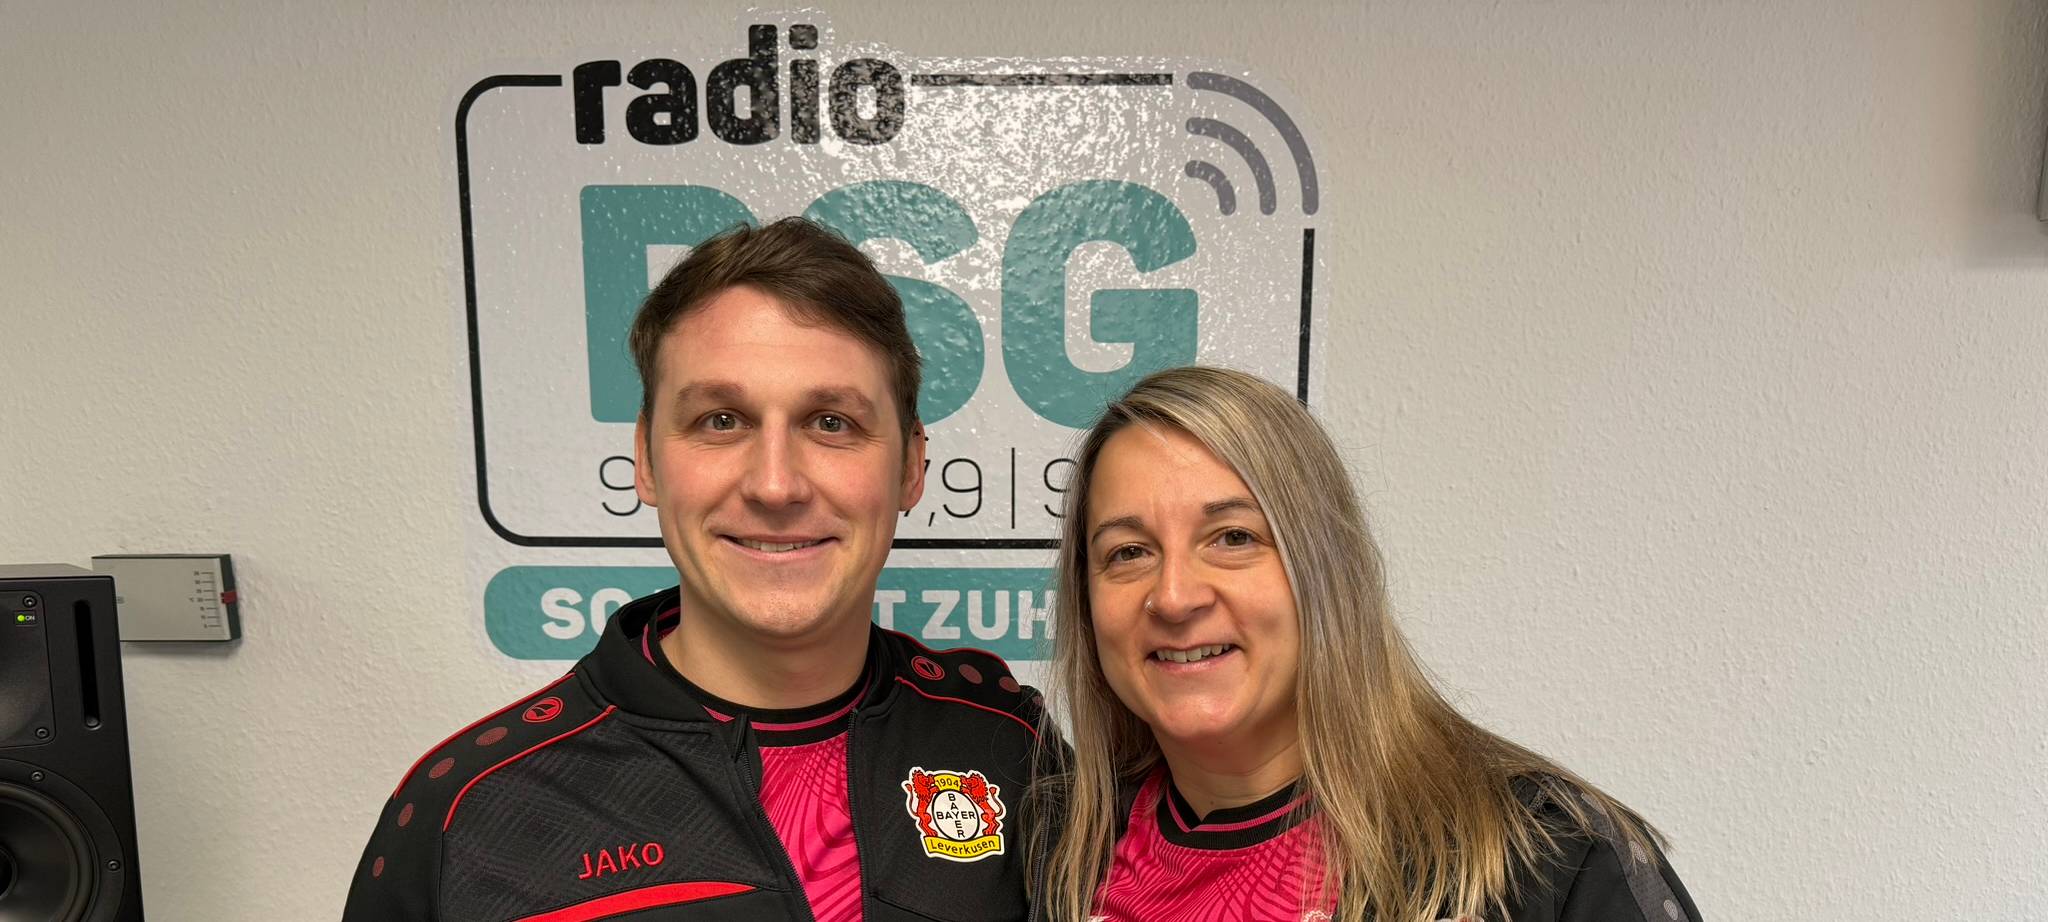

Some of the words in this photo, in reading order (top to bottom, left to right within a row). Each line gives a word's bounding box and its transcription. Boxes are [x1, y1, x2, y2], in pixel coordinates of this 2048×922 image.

[572, 24, 907, 146] radio
[921, 589, 1058, 641] ZUH
[936, 777, 960, 788] 1904
[936, 811, 977, 820] BAYER
[930, 839, 996, 855] Leverkusen
[578, 842, 665, 880] JAKO
